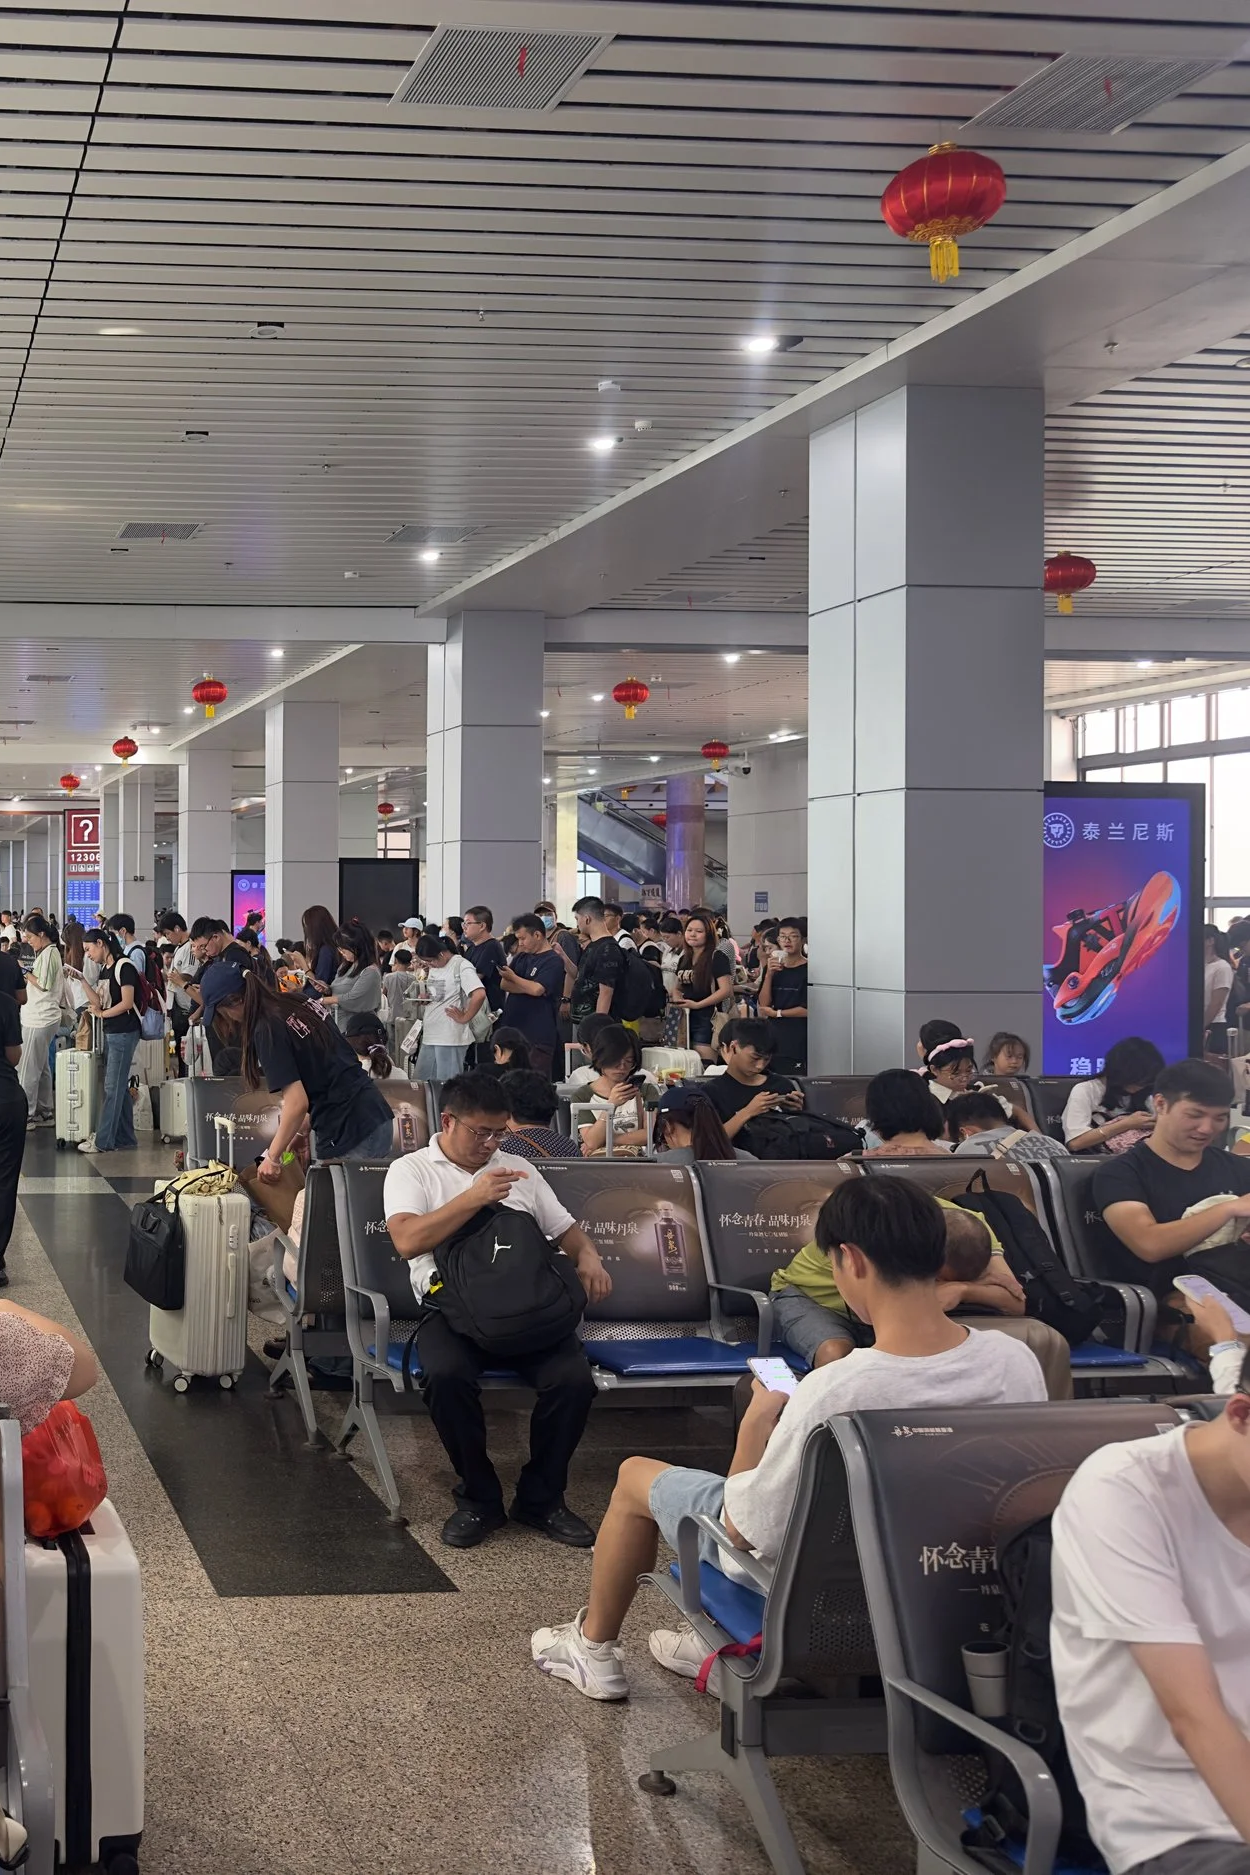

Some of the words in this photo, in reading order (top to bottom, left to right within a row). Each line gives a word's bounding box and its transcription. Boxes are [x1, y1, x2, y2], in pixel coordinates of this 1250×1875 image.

[1082, 822, 1175, 842] 泰兰尼斯
[70, 853, 100, 861] 12306
[364, 1219, 390, 1236] 怀念
[594, 1220, 640, 1236] 品味丹泉
[718, 1211, 766, 1228] 怀念青春
[768, 1213, 812, 1228] 品味丹泉
